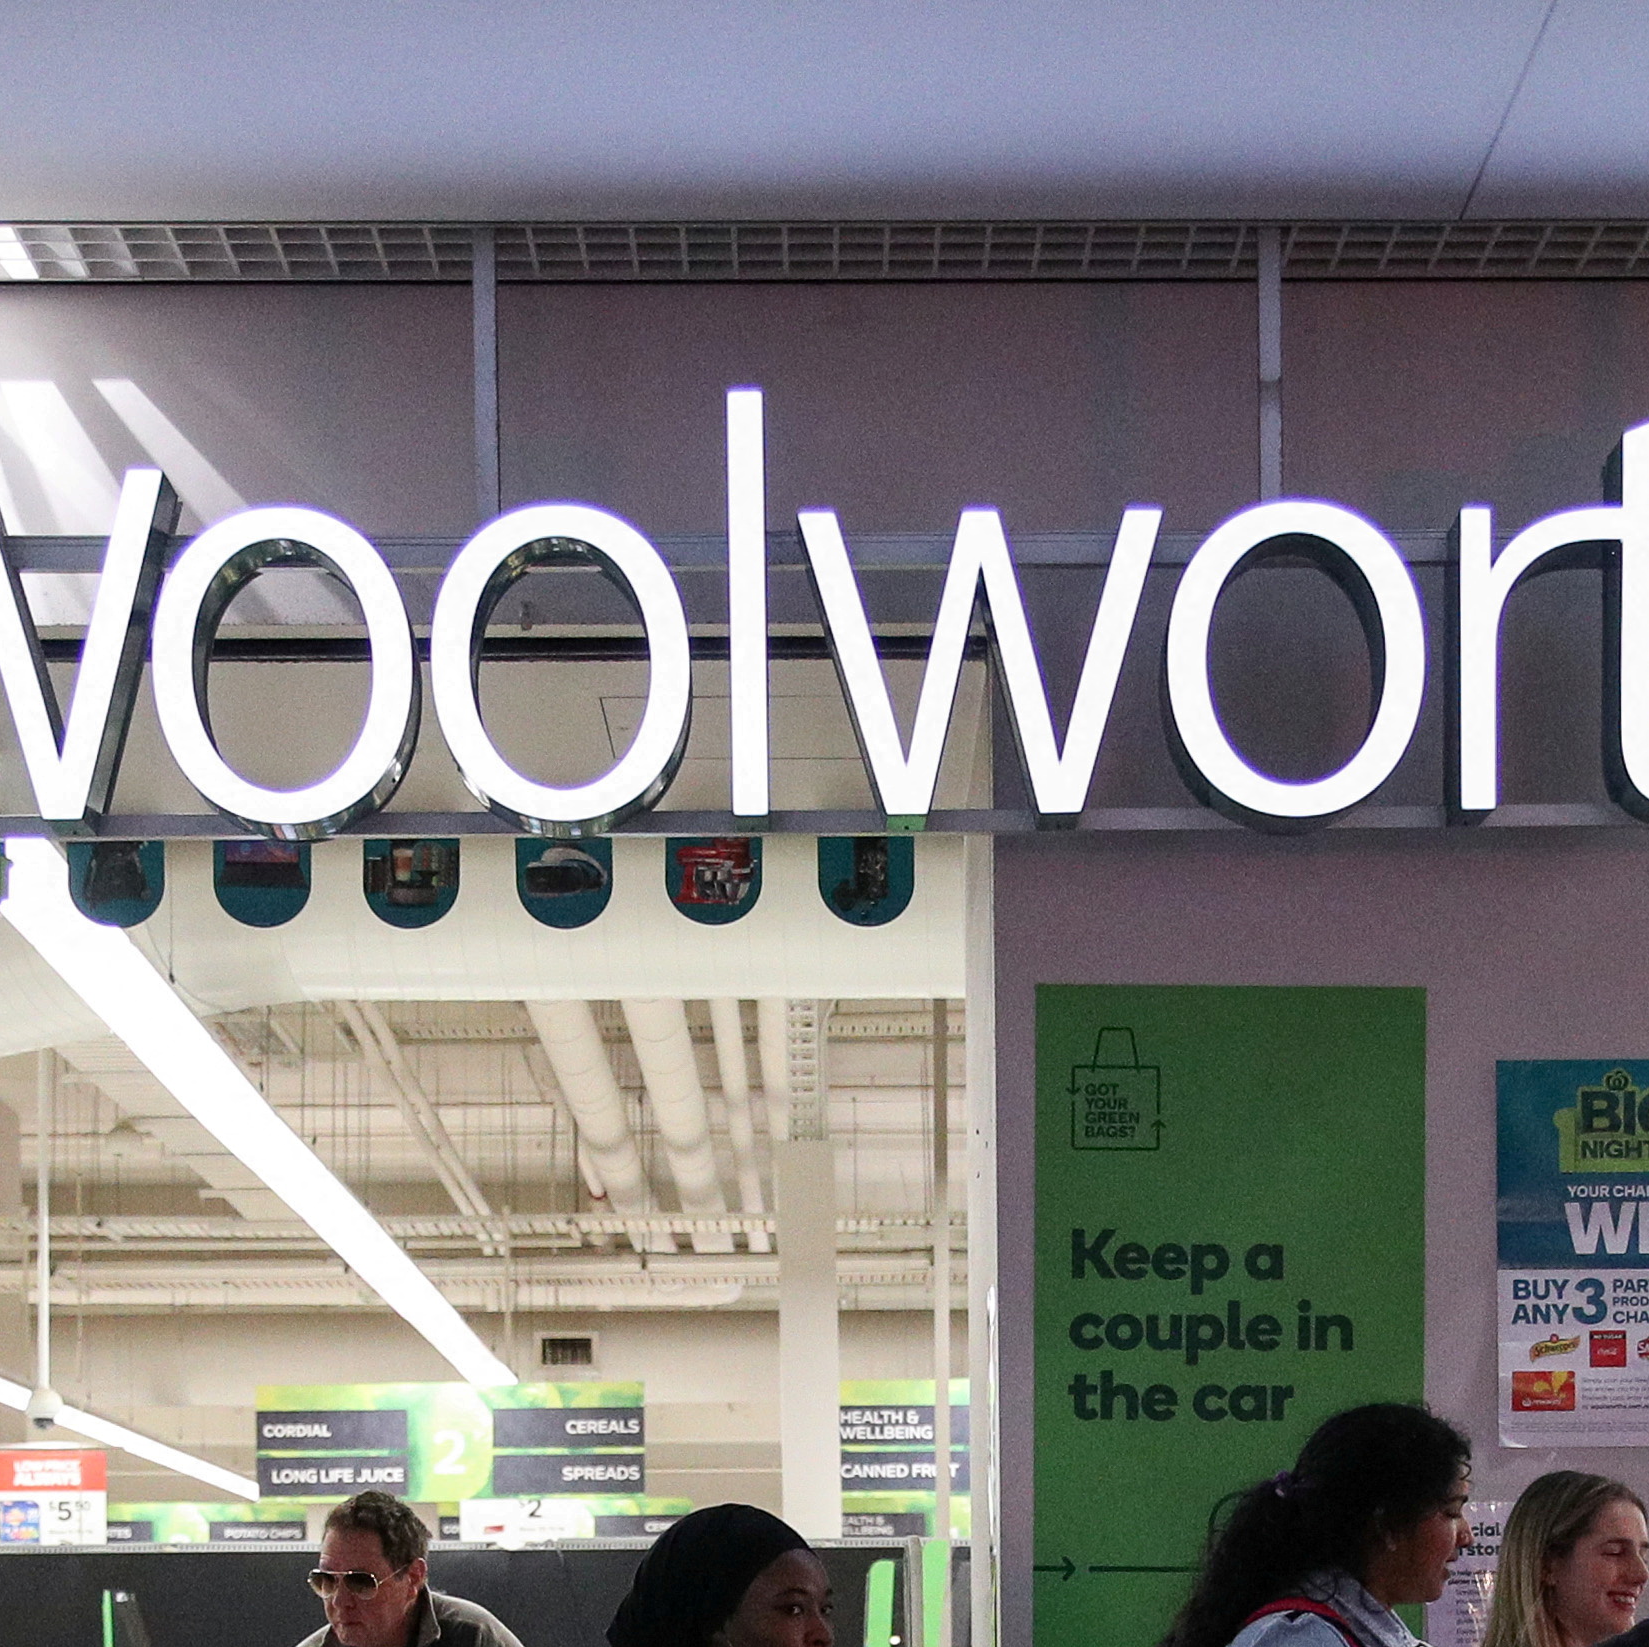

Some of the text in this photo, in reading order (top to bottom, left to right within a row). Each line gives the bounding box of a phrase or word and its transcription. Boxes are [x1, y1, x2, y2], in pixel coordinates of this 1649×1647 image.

[1084, 1083, 1119, 1097] GOT
[1084, 1098, 1128, 1111] YOUR
[1084, 1112, 1140, 1125] GREEN
[1084, 1125, 1136, 1139] BAGS?
[1568, 1185, 1610, 1197] YOUR
[1071, 1229, 1284, 1295] Keep a
[1512, 1278, 1608, 1324] BUY 3
[1511, 1304, 1572, 1325] ANY
[1069, 1299, 1354, 1365] couple in
[1067, 1370, 1295, 1421] the car
[840, 1410, 919, 1424] HEALTH &
[263, 1423, 332, 1439] CORDIAL
[564, 1419, 640, 1435] CEREALS
[840, 1426, 933, 1439] WELLBEING
[432, 1430, 467, 1475] 2
[270, 1467, 405, 1485] LONG LIFE JUICE
[561, 1465, 640, 1482] SPREADS
[841, 1464, 909, 1478] CANNED
[224, 1529, 264, 1540] POTATO
